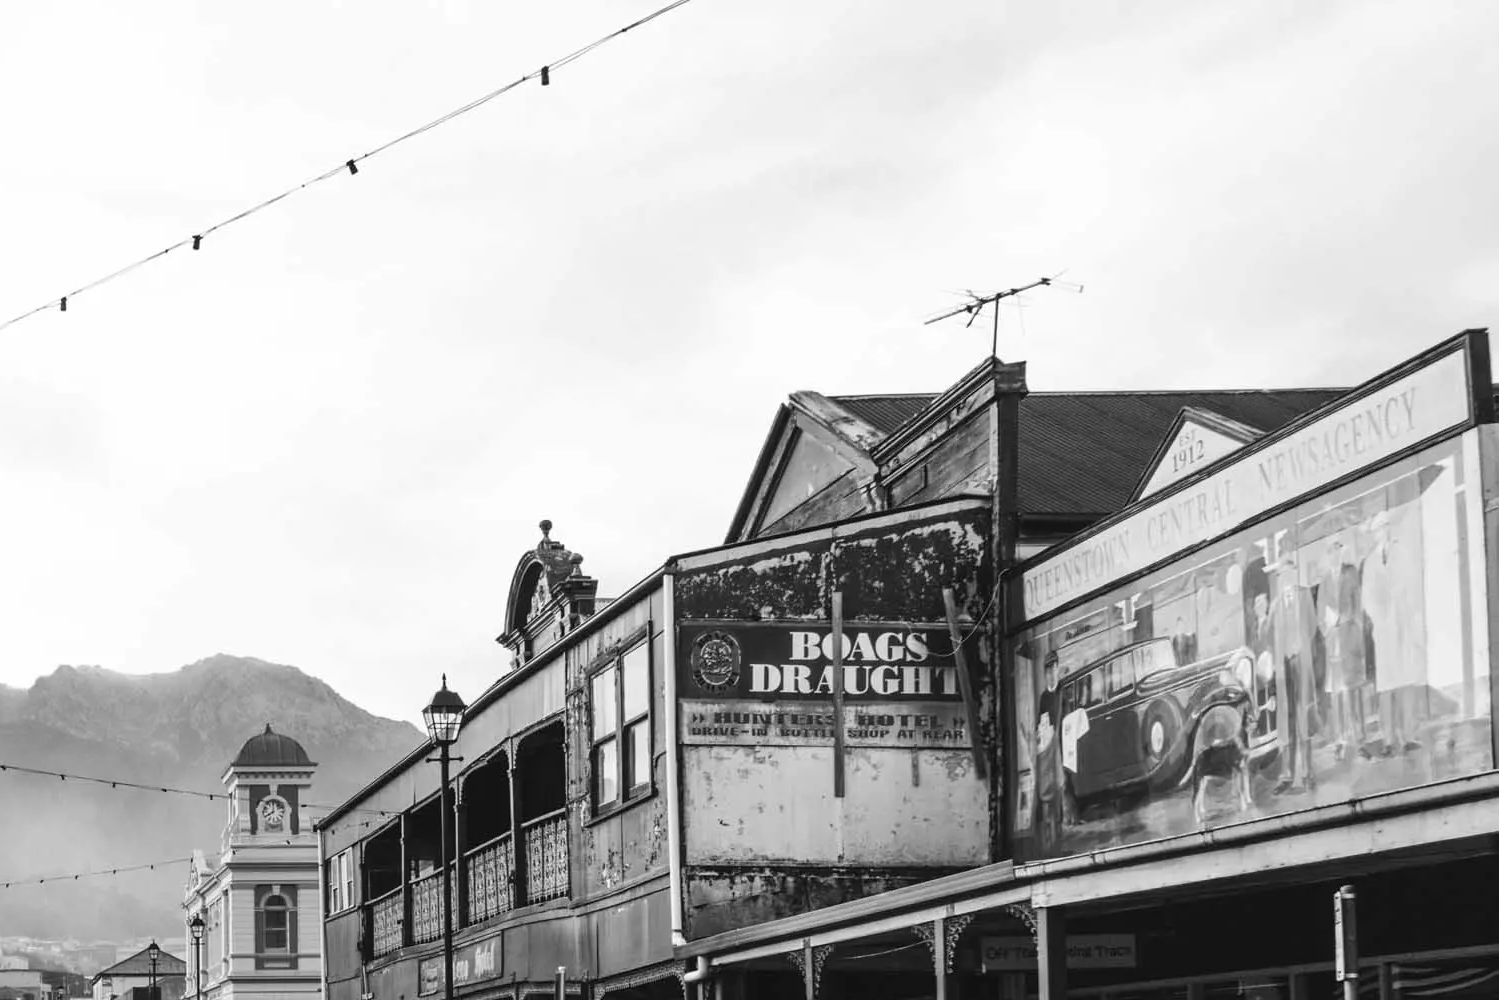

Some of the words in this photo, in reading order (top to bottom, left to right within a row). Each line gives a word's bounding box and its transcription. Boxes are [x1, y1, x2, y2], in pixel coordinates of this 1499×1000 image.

[1172, 440, 1205, 473] 1912
[1024, 530, 1132, 614] QUEENSTOWN
[1146, 480, 1236, 546] CENTRAL
[1258, 387, 1418, 492] NEWSAGENCY
[789, 631, 928, 662] BOAGS
[749, 664, 959, 694] DRAUGHT
[692, 727, 768, 737] DRIVE-IN
[848, 729, 890, 739] SHOP
[897, 729, 916, 739] AT
[858, 714, 941, 728] HOTEL
